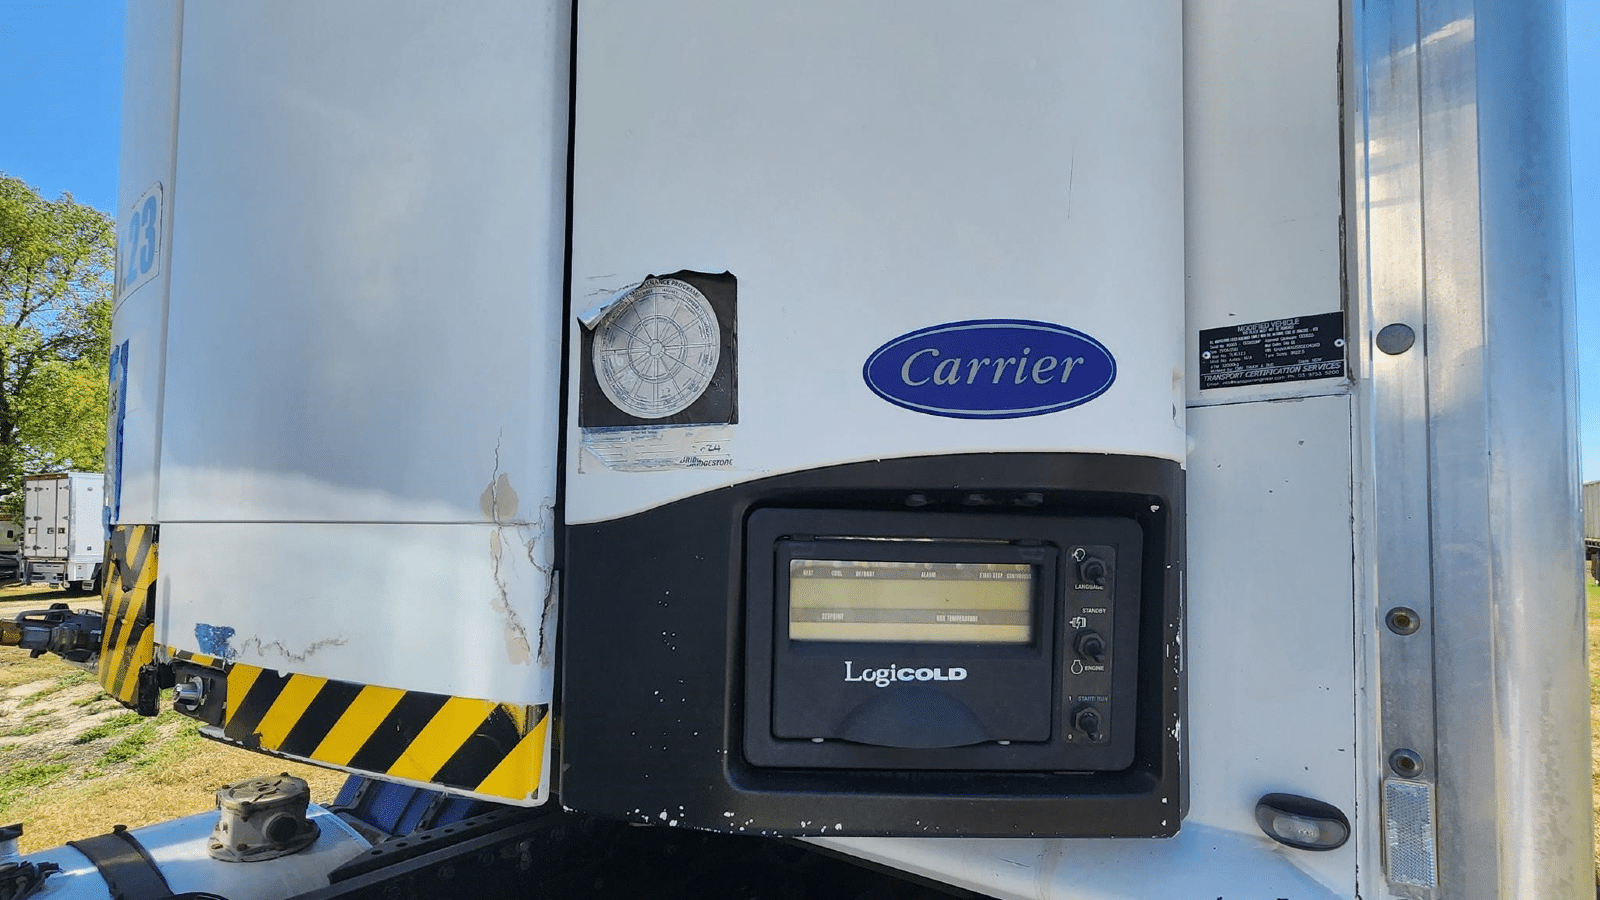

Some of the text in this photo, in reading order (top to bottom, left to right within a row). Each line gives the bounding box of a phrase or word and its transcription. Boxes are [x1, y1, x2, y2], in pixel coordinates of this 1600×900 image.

[1237, 322, 1270, 333] MODIFIED
[1270, 318, 1300, 328] VEHICLE
[901, 347, 1084, 387] Carrier
[1203, 361, 1342, 382] TRANSPORT CERTIFICATION SERVICES
[844, 660, 967, 688] LogiCOLD
